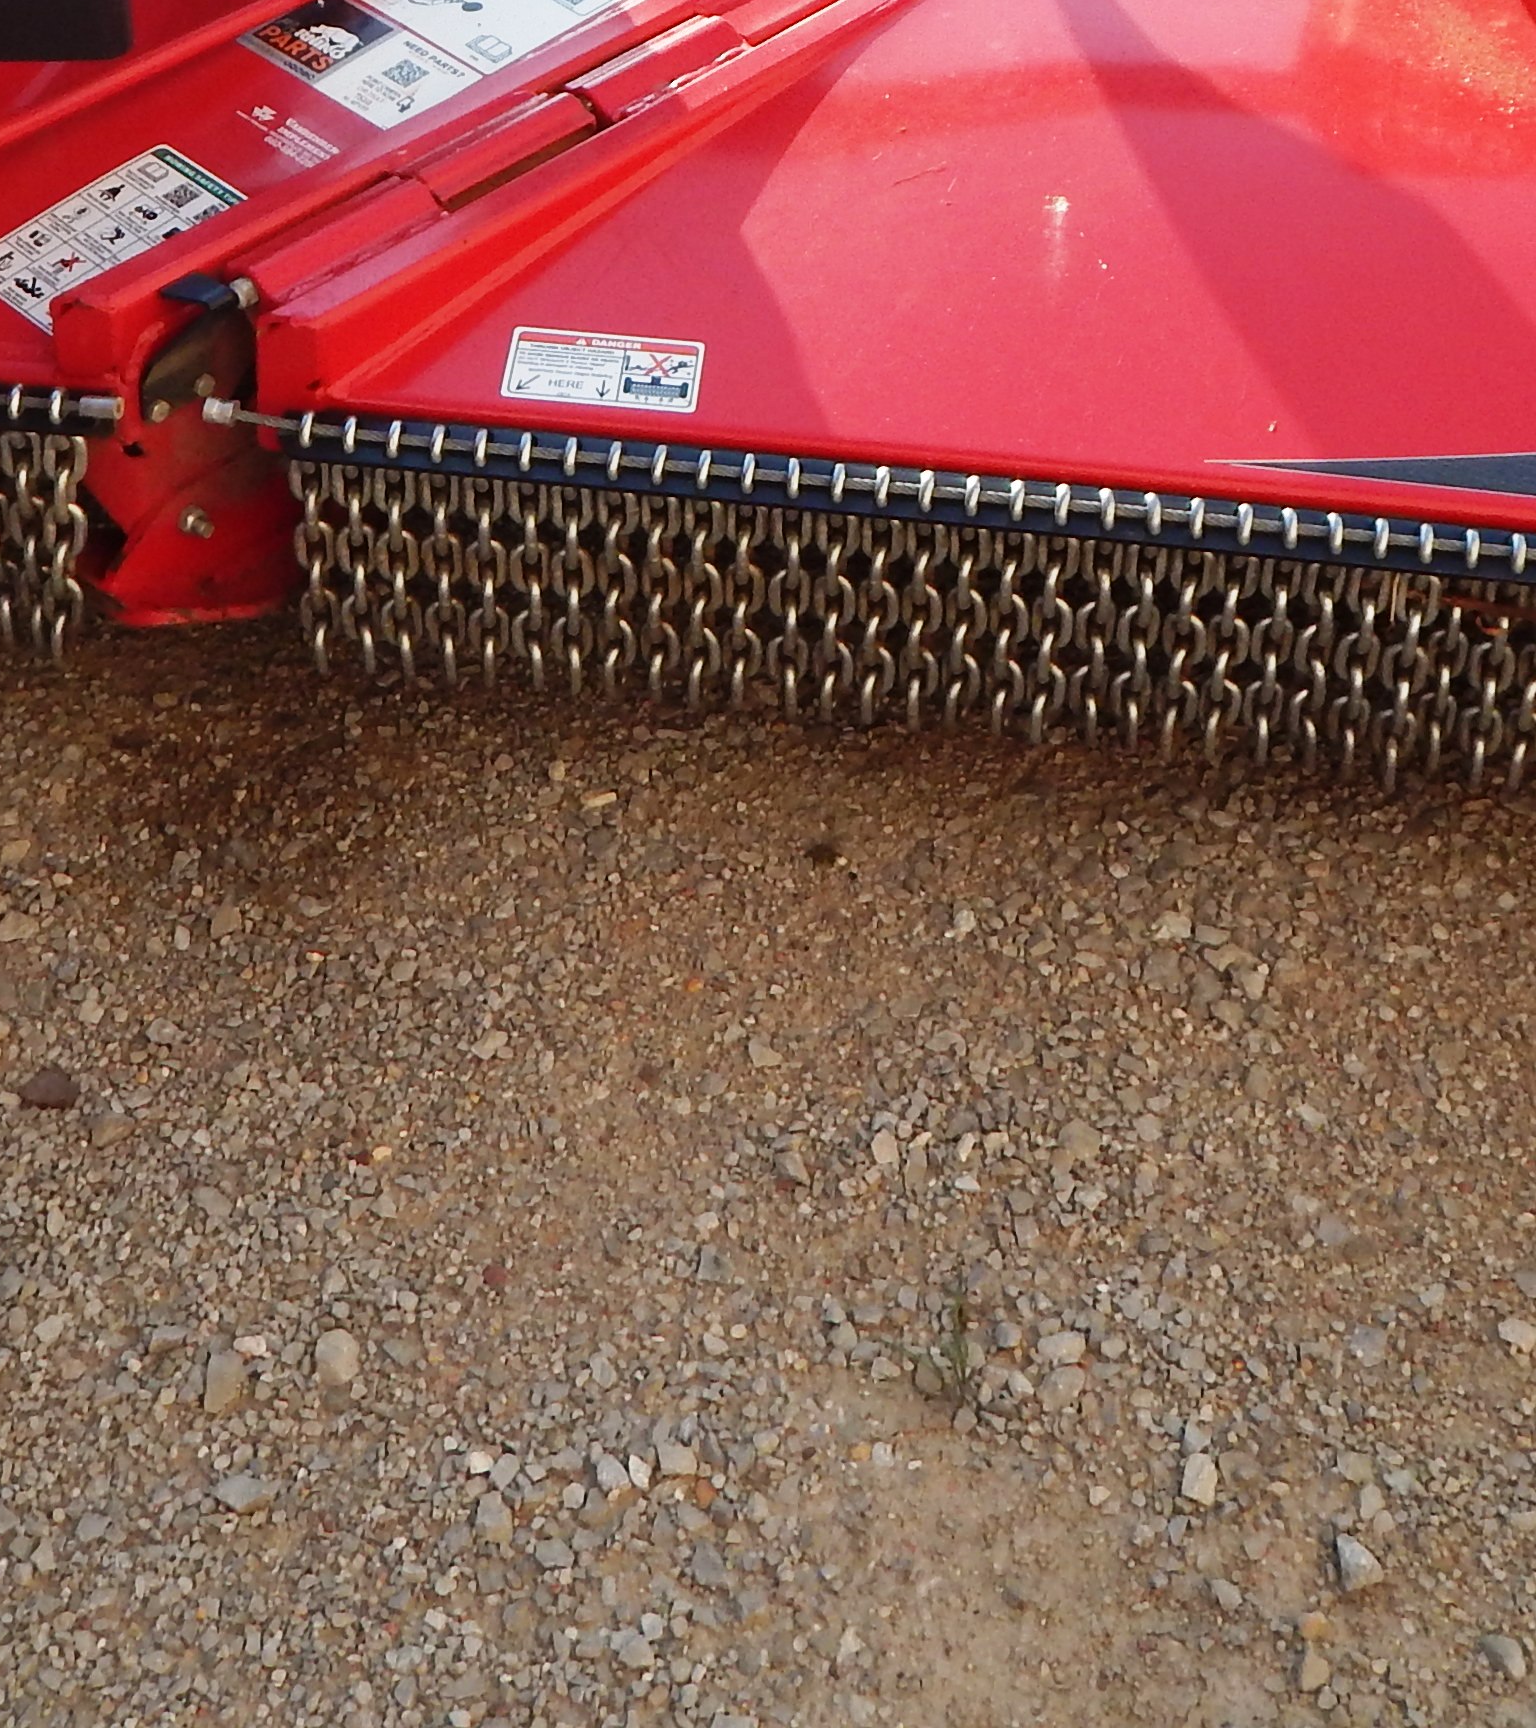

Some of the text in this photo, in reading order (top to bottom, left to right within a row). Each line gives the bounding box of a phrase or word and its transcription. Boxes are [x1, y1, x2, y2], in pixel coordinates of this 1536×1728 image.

[258, 24, 334, 72] PARTS
[403, 39, 467, 79] NEED PARTS?
[591, 338, 642, 350] DANGER
[548, 378, 585, 390] HERE
